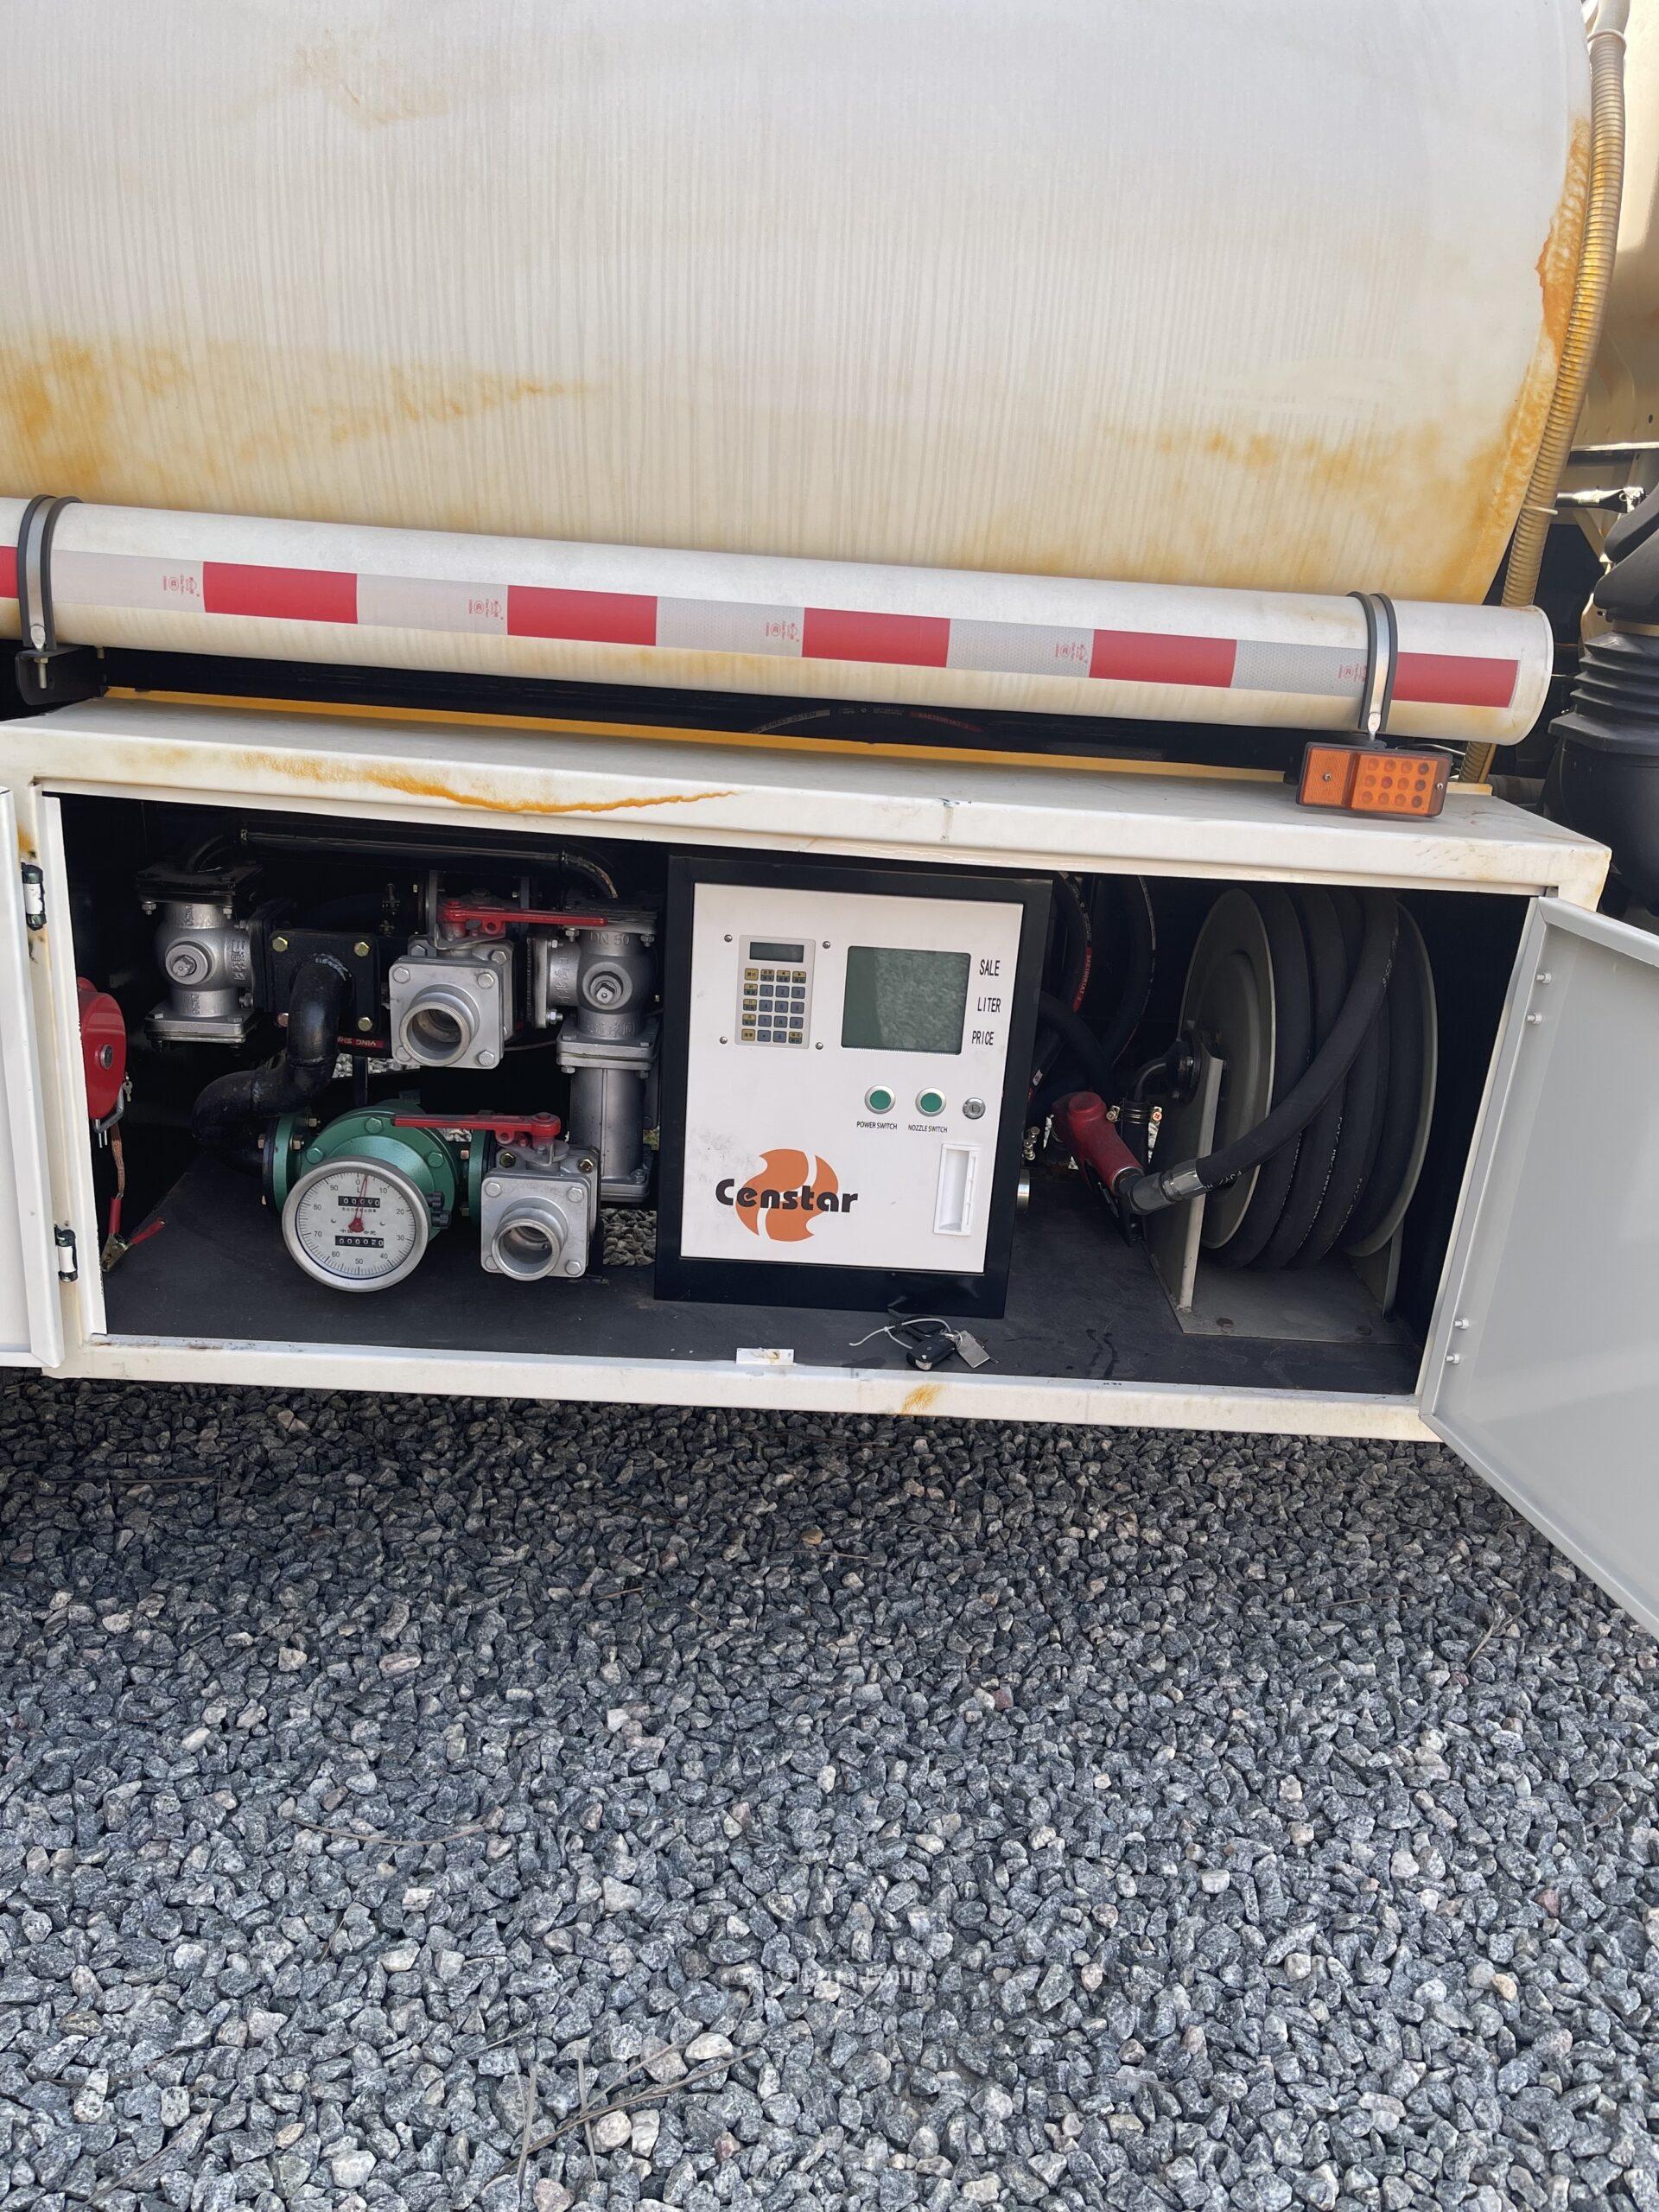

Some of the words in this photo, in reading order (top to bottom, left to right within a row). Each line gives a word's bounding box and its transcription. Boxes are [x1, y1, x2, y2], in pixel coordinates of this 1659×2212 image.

[979, 959, 1000, 976] SALE
[977, 996, 1001, 1013] LITER
[971, 1030, 995, 1046] PRICE
[715, 1178, 858, 1213] Censtar
